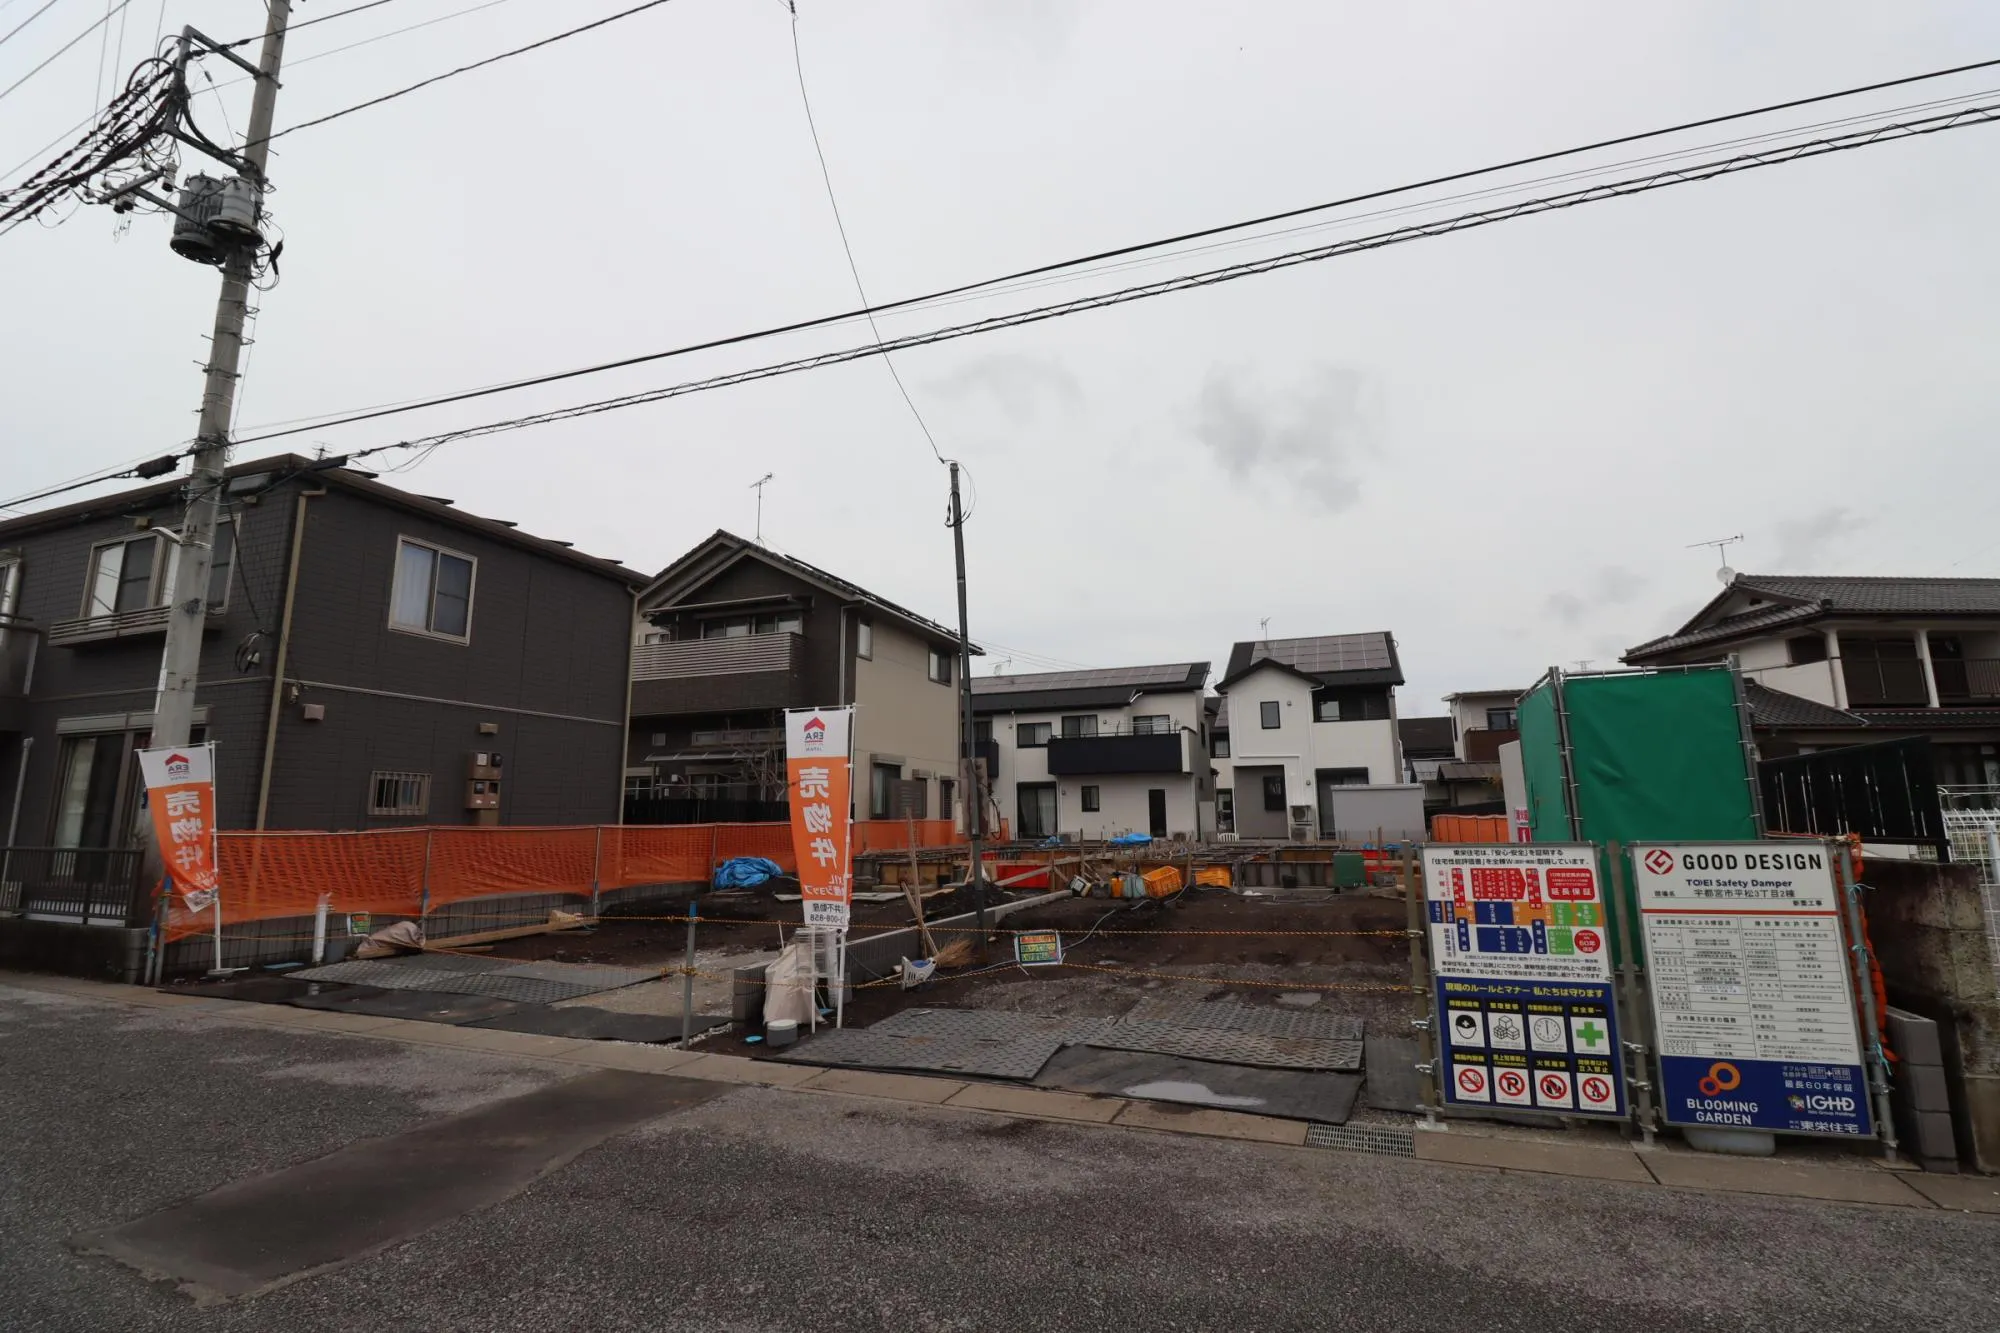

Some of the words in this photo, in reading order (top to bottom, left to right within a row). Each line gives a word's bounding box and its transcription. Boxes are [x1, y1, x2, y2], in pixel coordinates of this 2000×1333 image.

[1682, 853, 1738, 871] GOOD
[1745, 853, 1822, 870] DESIGN
[1715, 878, 1748, 889] Safety
[1751, 879, 1793, 889] Damper
[1551, 887, 1592, 896] 延長保証
[1444, 982, 1531, 995] 現場のルールとマナー
[1533, 987, 1604, 998] 私たちは守ります
[1571, 1006, 1603, 1014] 安全第一
[1578, 1066, 1609, 1074] 立入禁止
[1784, 1079, 1854, 1092] 最長60年保証
[1686, 1097, 1759, 1114] BLOOMING
[1695, 1110, 1753, 1126] GARDEN
[1799, 1120, 1860, 1134] 東栄住宅
